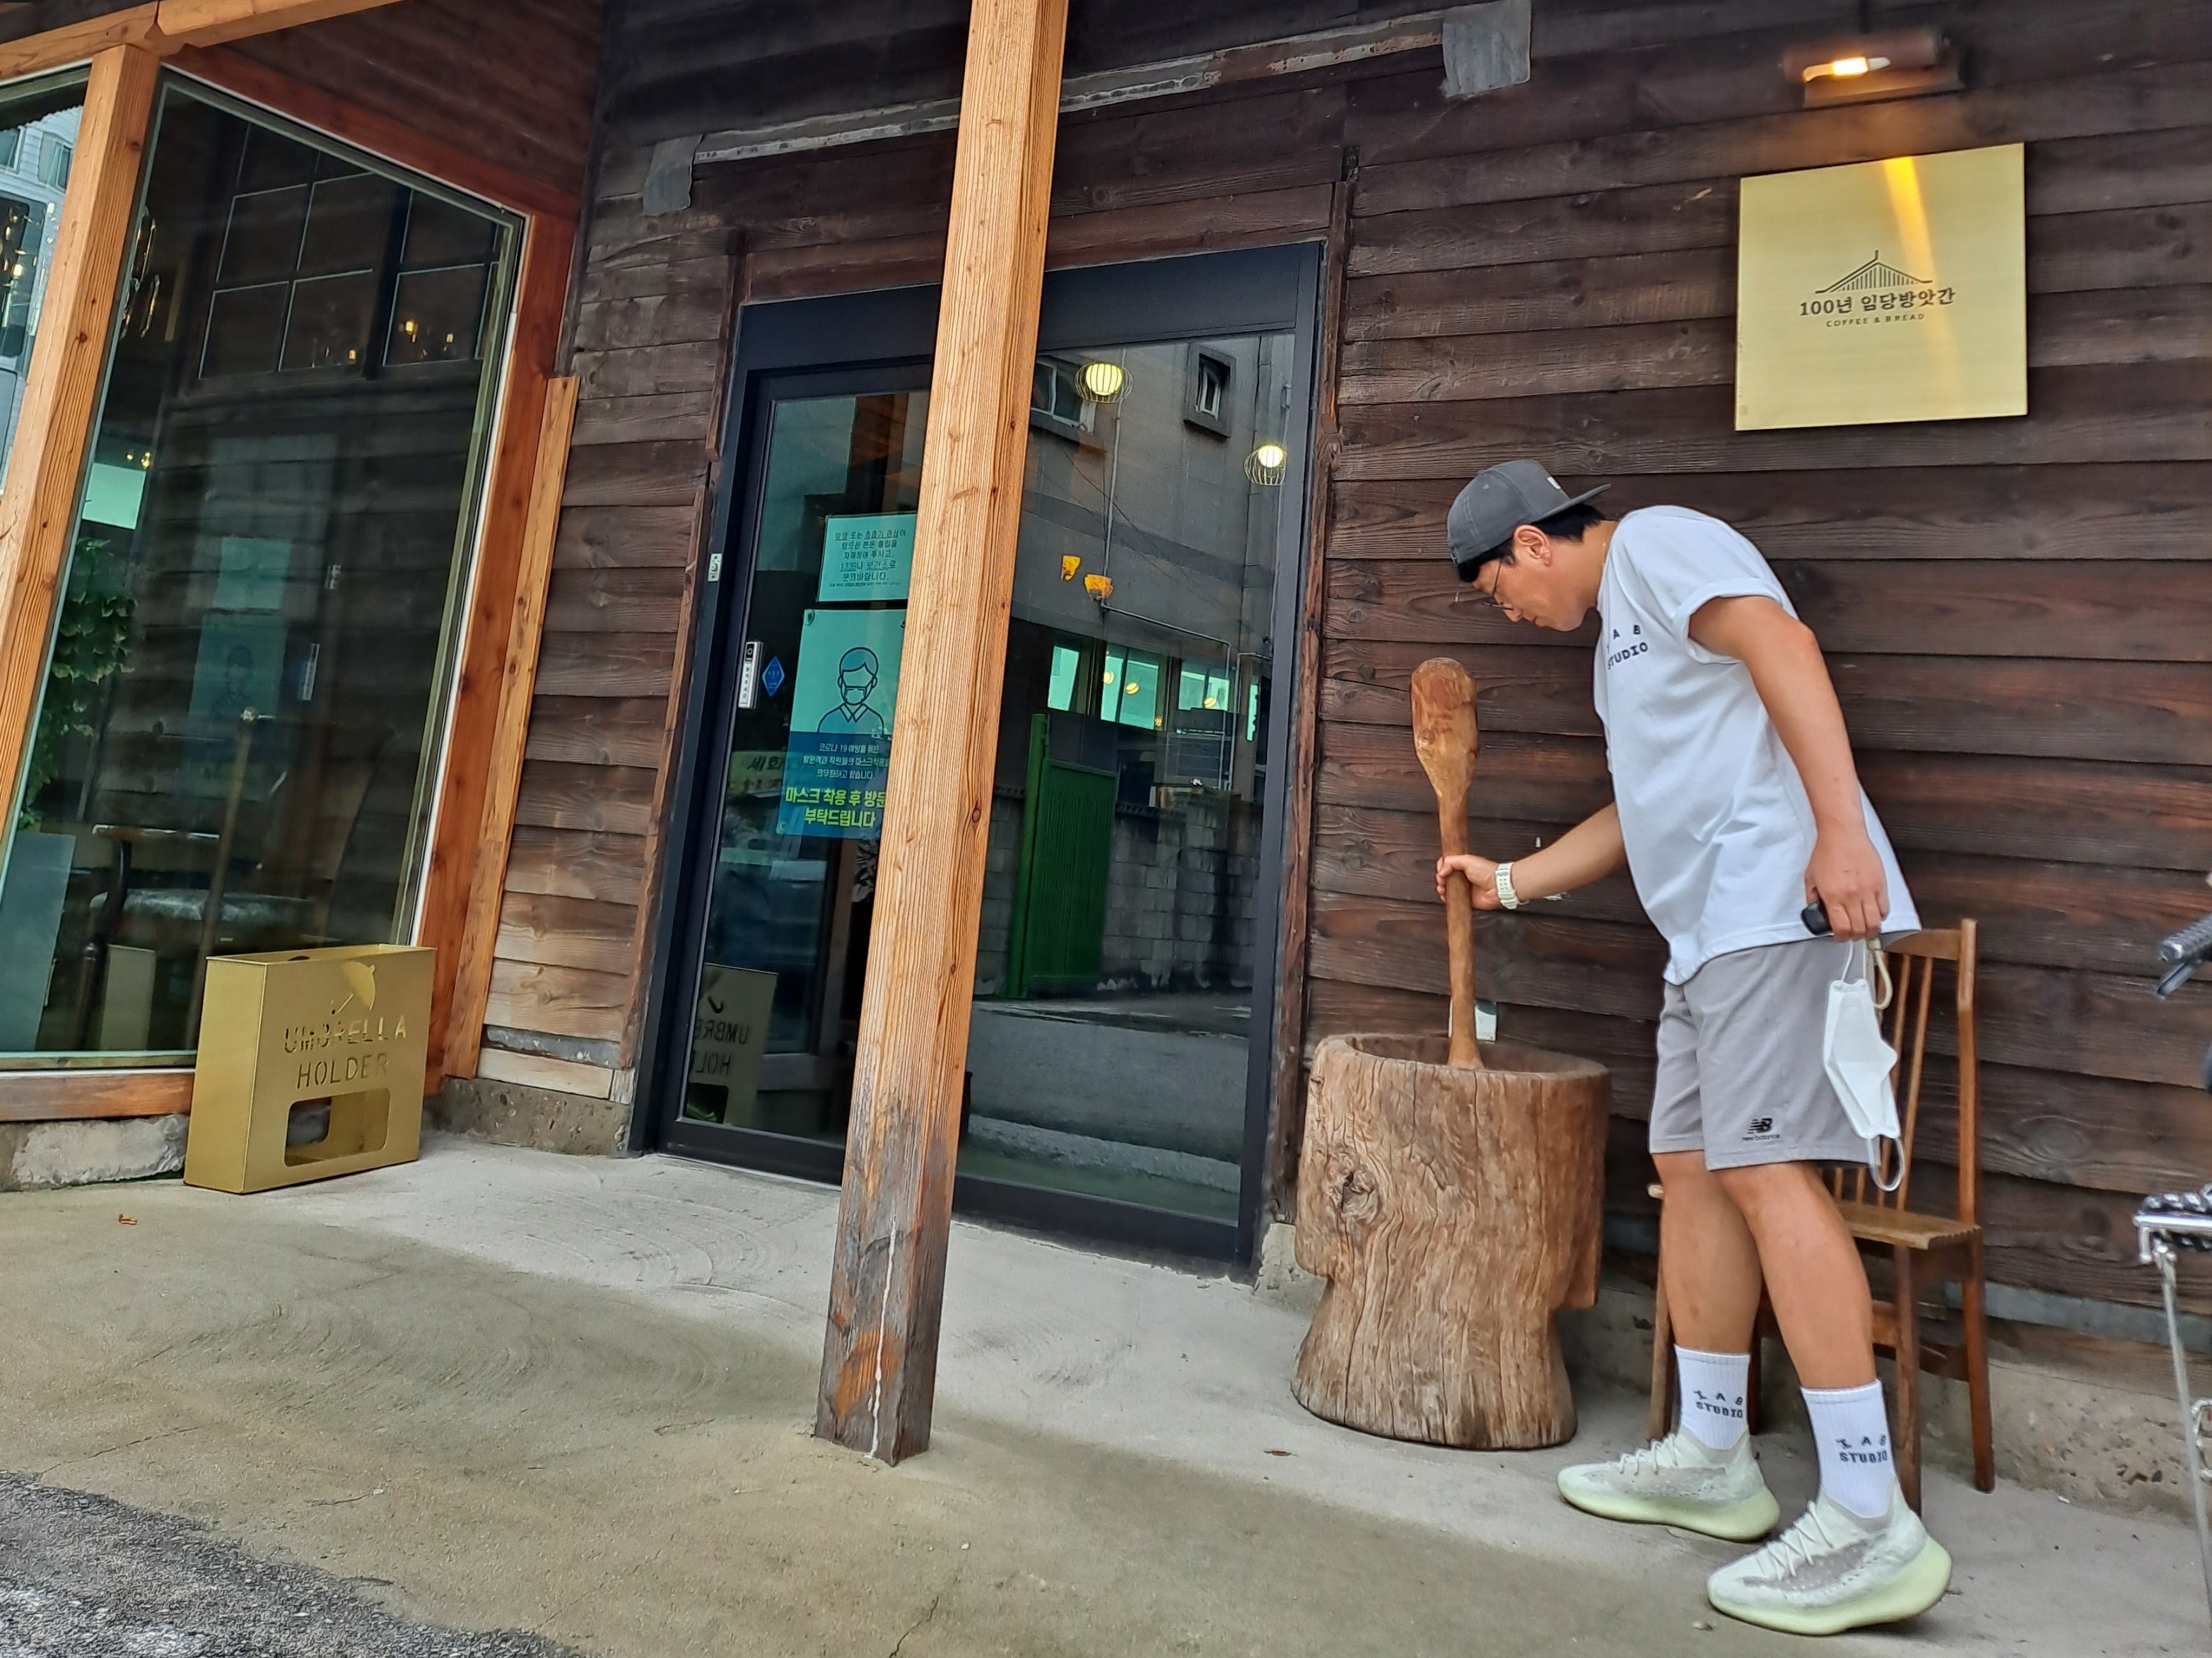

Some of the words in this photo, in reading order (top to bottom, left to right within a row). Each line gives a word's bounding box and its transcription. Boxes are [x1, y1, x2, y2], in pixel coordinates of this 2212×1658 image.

[1800, 295, 1852, 316] 100년
[1861, 287, 1955, 312] 임당방앗간
[1826, 317, 1868, 327] COFFEE
[1885, 313, 1925, 322] BREAD
[819, 743, 838, 752] 코로나
[785, 787, 820, 804] 마스크
[823, 788, 847, 806] 착용
[849, 789, 862, 806] 후
[804, 807, 876, 828] 부탁드립니다
[297, 1052, 388, 1089] HOLDER
[1696, 1401, 1743, 1418] STUDIO
[1839, 1450, 1888, 1463] STUDIO
